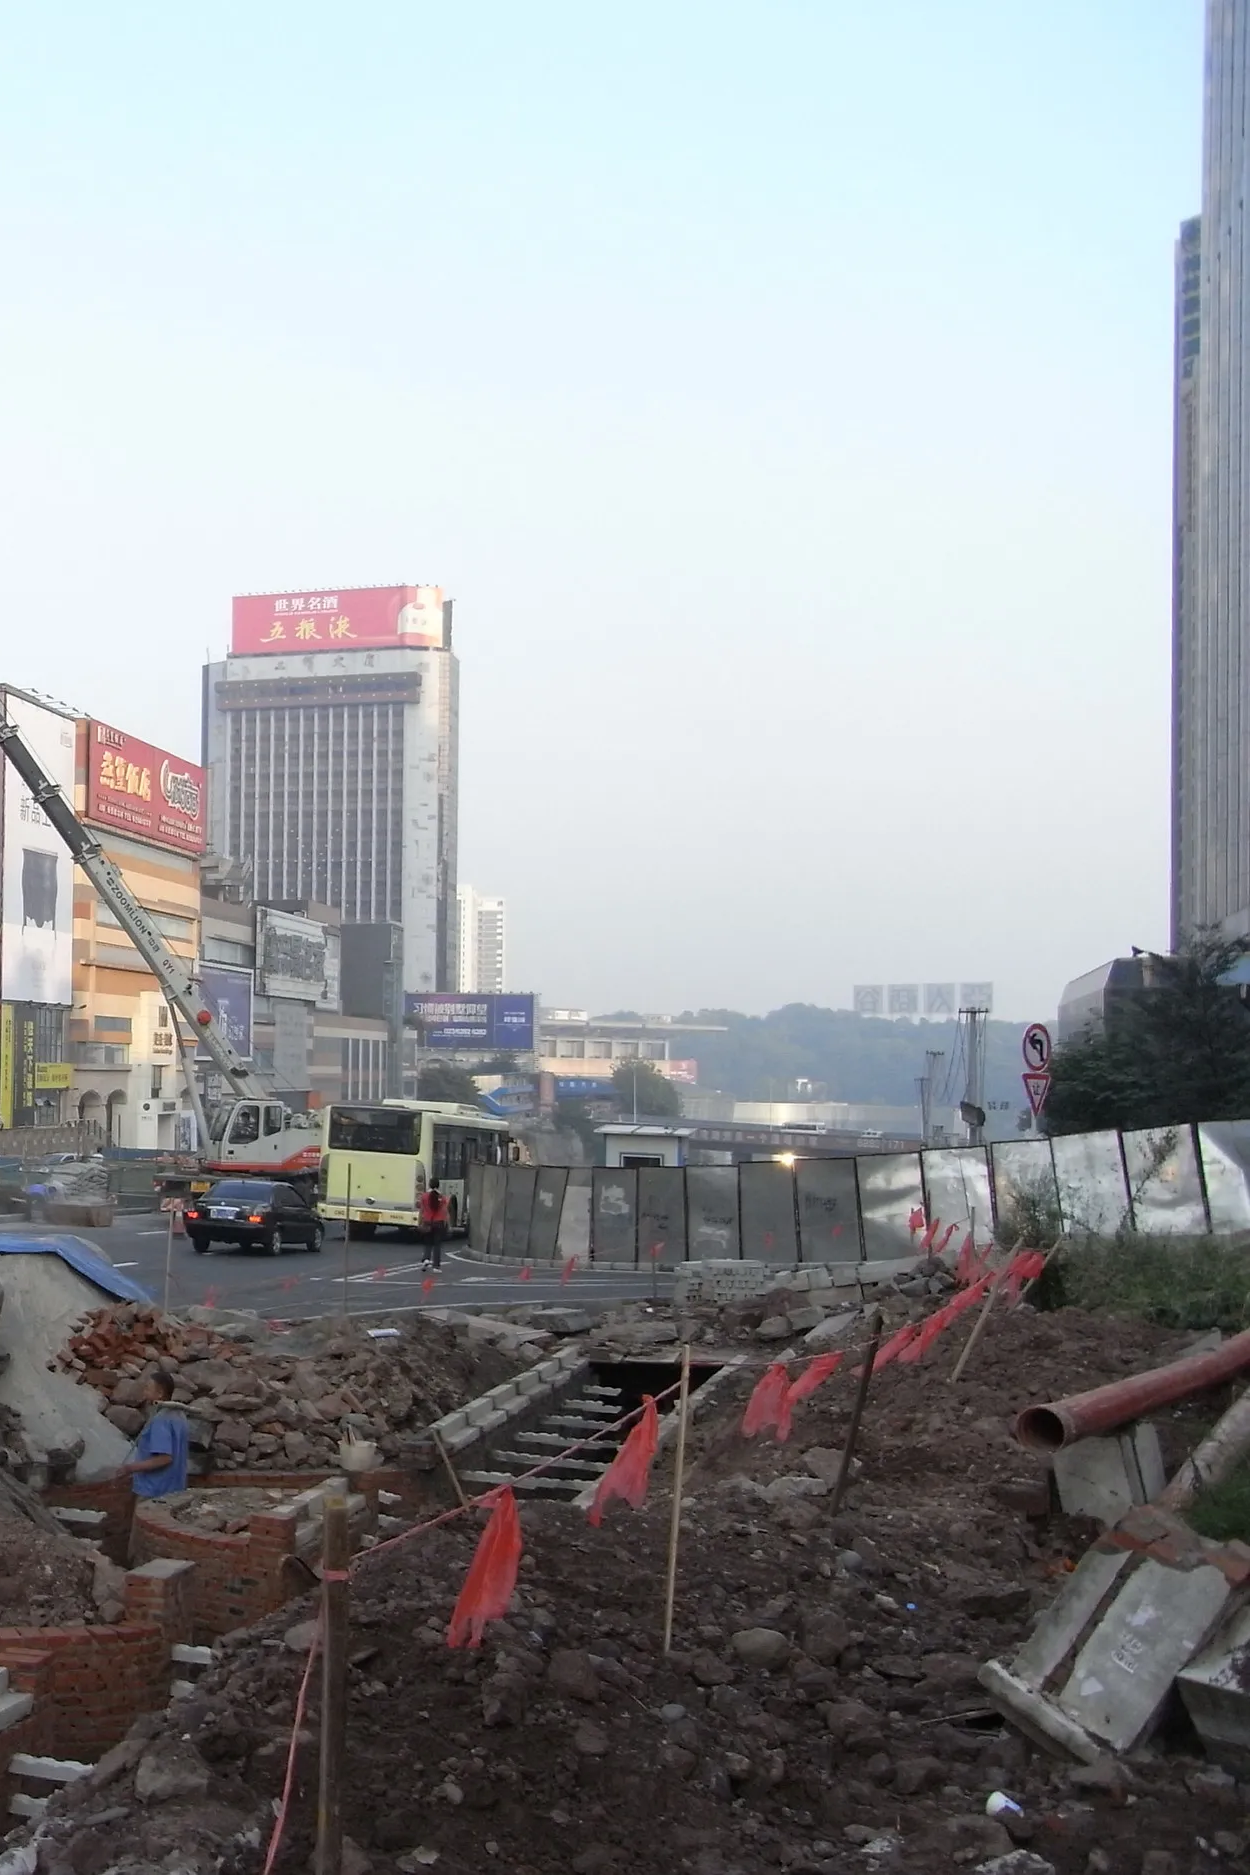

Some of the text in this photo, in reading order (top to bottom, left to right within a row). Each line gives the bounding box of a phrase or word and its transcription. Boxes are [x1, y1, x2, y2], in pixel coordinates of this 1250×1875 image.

[273, 595, 338, 613] 世界名酒
[259, 616, 358, 643] 五粮液
[110, 883, 147, 934] ZOOMLION
